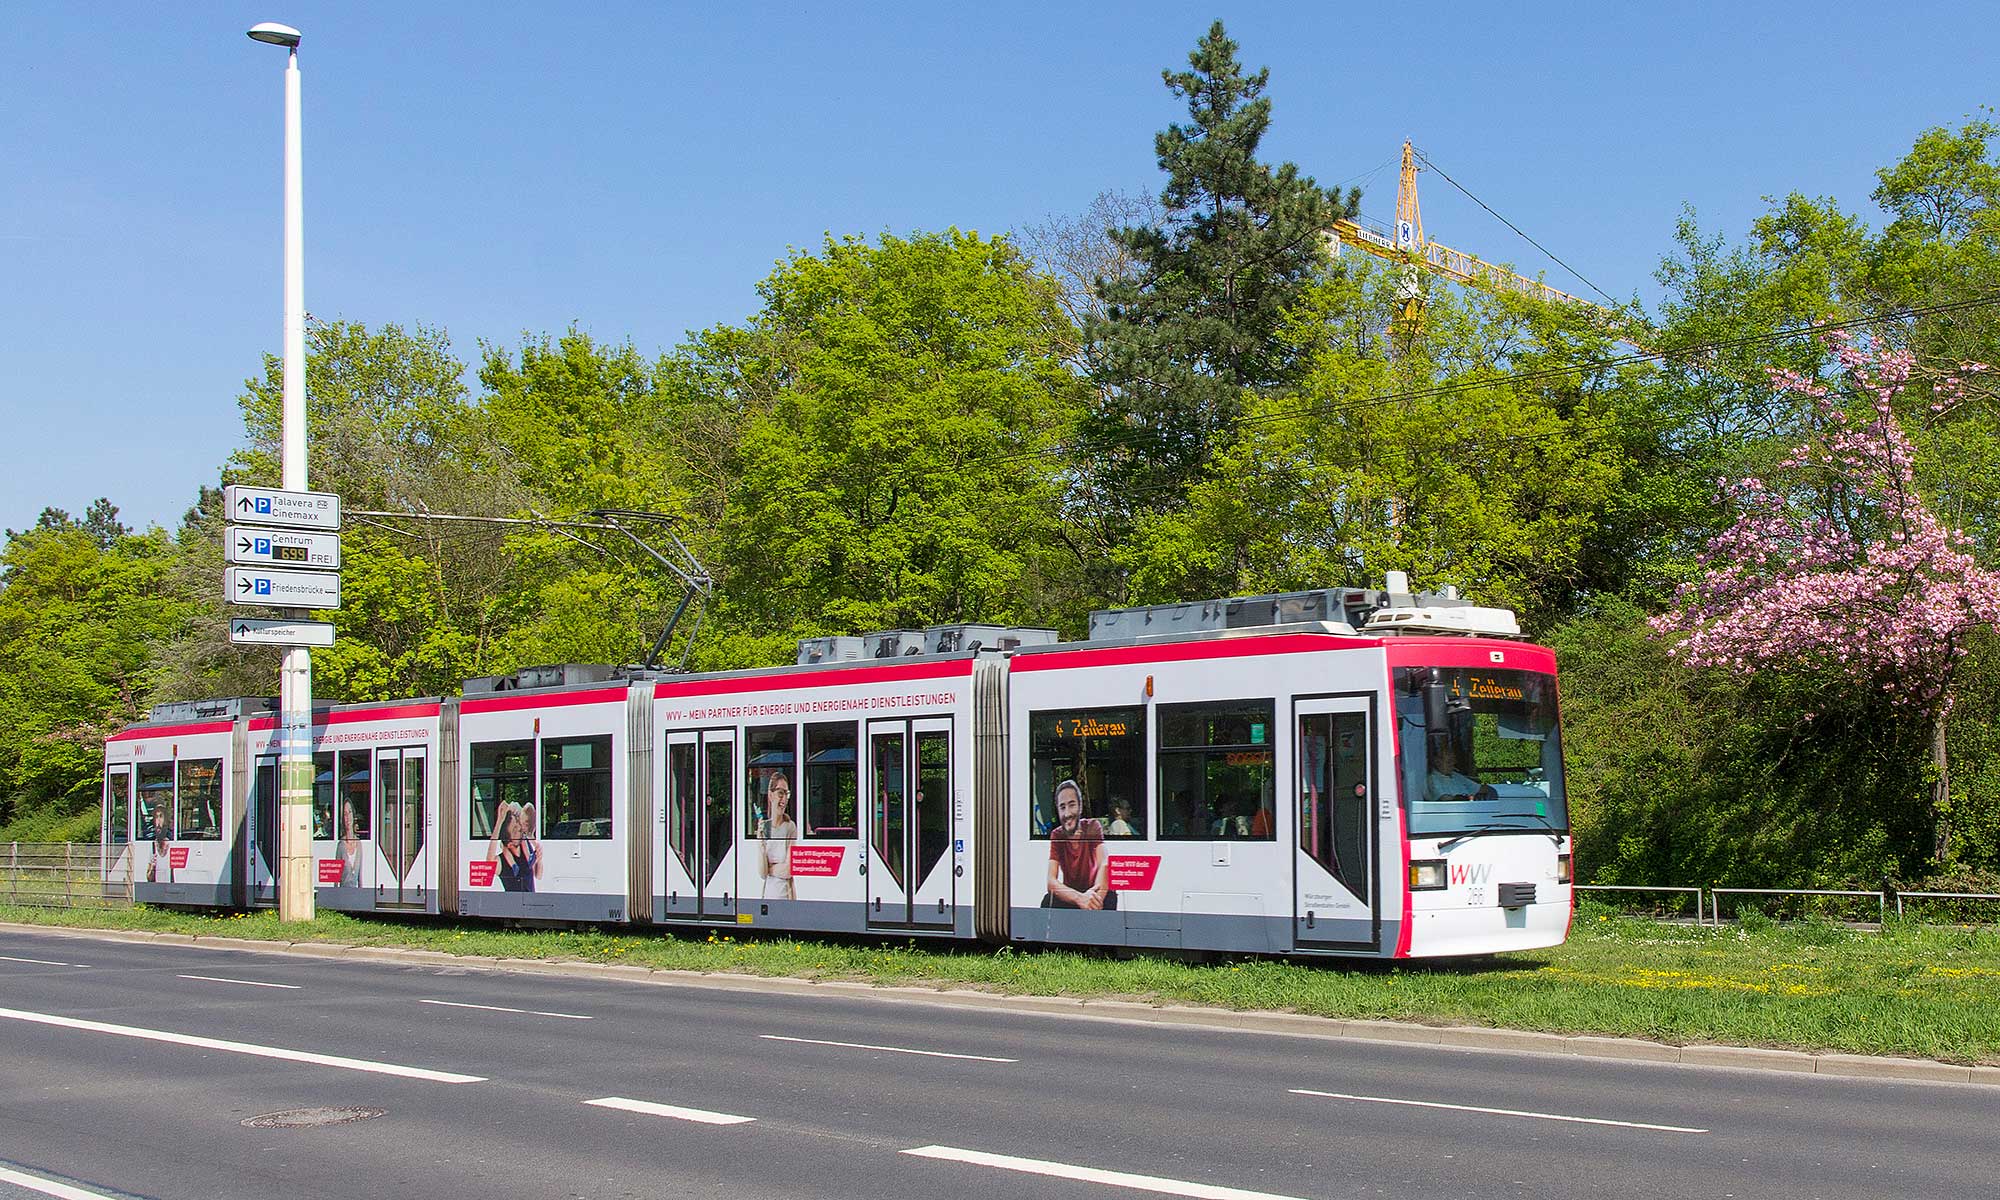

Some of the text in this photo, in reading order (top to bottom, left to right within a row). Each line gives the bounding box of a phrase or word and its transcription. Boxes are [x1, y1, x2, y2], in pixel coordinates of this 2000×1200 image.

[273, 496, 313, 508] Talavera
[272, 508, 319, 520] Cinemaxx
[271, 533, 313, 545] Centrum
[281, 547, 305, 560] 699
[311, 554, 333, 564] FREI
[272, 583, 324, 595] Friedensbrücke
[253, 628, 296, 637] Kulturspeicher
[1469, 677, 1523, 699] Zellerau
[665, 711, 682, 721] WVV
[689, 708, 707, 720] MEIN
[708, 706, 741, 719] PARTNER
[743, 703, 759, 716] FÜR
[760, 703, 792, 716] ENERGIE
[794, 701, 810, 713] UND
[812, 697, 869, 713] ENERGIENAHE
[871, 692, 956, 709] DIENSTLEISTUNGEN
[1071, 719, 1127, 737] Zellerau
[312, 728, 430, 745] ENERGIE UND ENERGIENAHE DIENSTLEISTUNGEN
[1451, 864, 1493, 885] WVV
